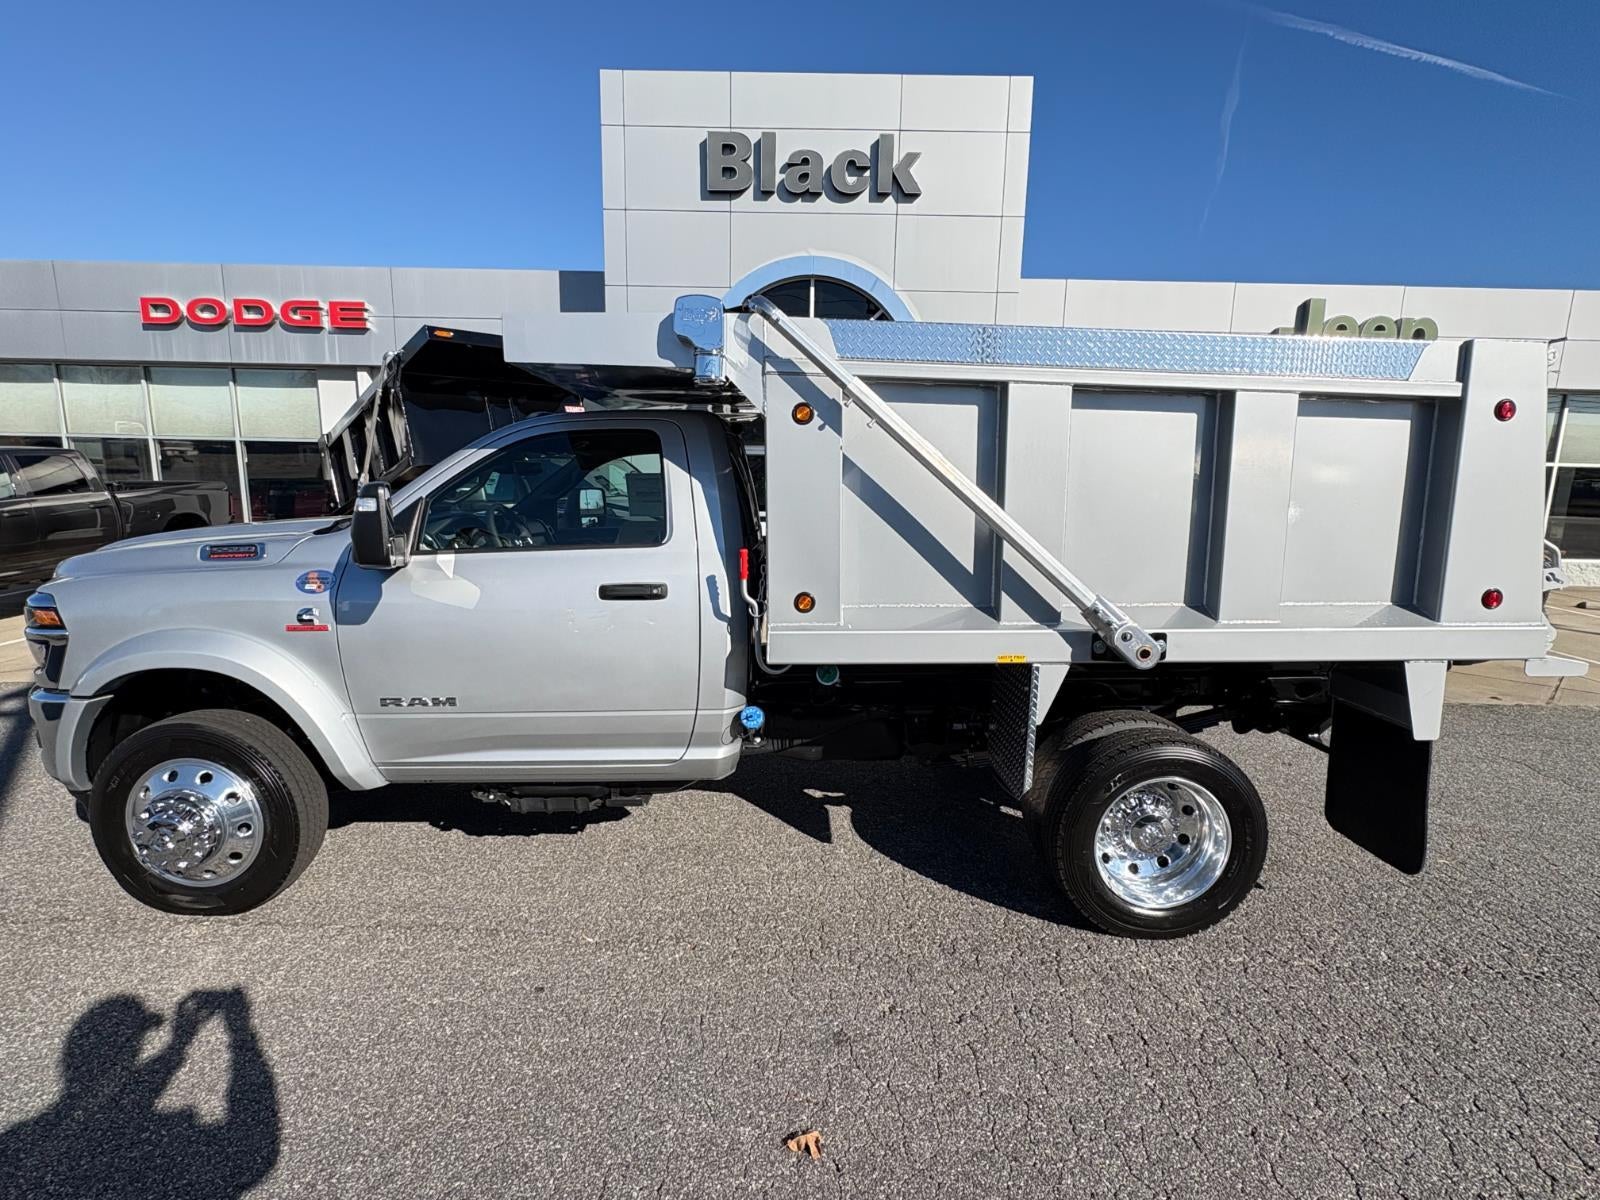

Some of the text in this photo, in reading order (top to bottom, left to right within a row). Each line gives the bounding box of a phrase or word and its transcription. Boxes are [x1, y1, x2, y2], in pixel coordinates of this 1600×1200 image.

[706, 130, 922, 196] Black
[139, 296, 369, 331] DODGE
[379, 696, 457, 707] RAM
